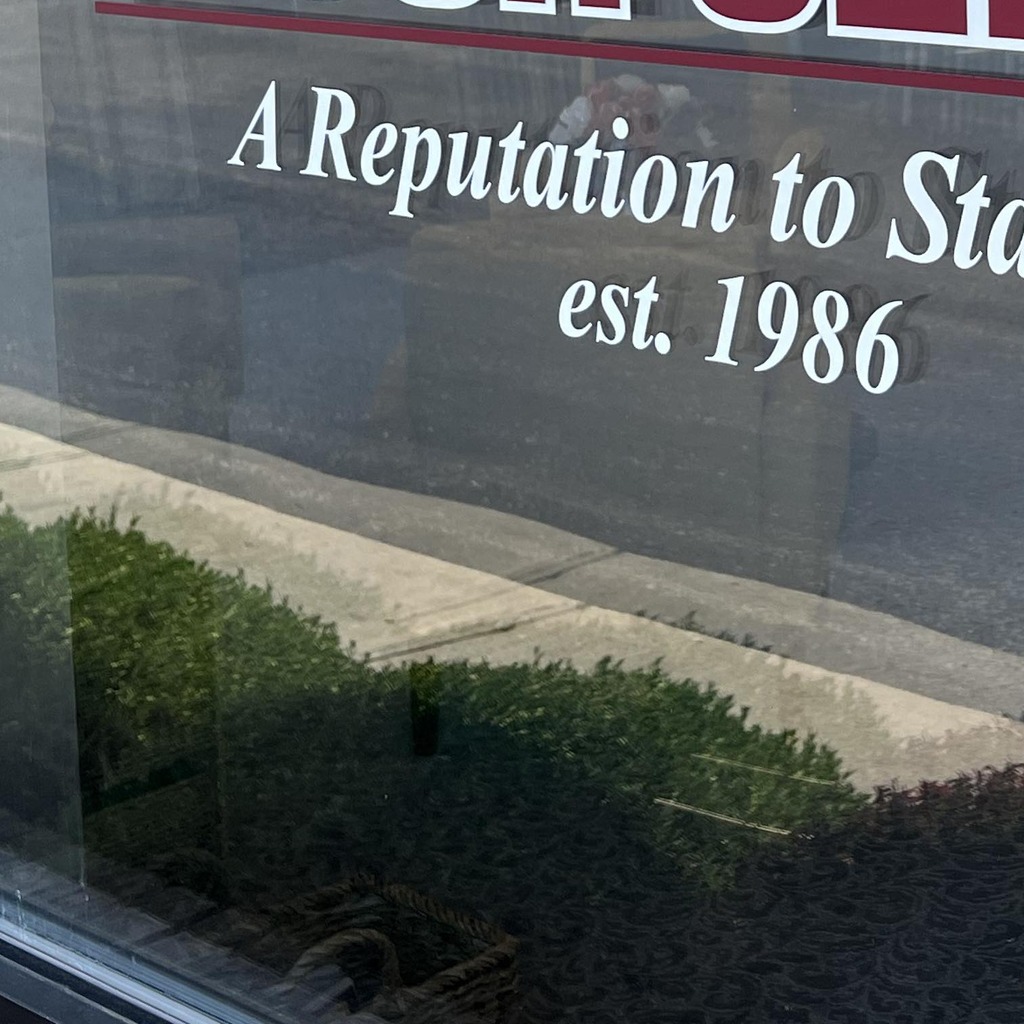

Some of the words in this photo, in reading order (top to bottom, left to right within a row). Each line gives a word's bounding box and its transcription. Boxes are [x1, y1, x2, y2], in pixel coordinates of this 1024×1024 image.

[227, 80, 282, 171] A
[299, 85, 736, 233] Reputation
[769, 153, 855, 249] to
[558, 276, 671, 355] est.
[704, 276, 903, 395] 1986
